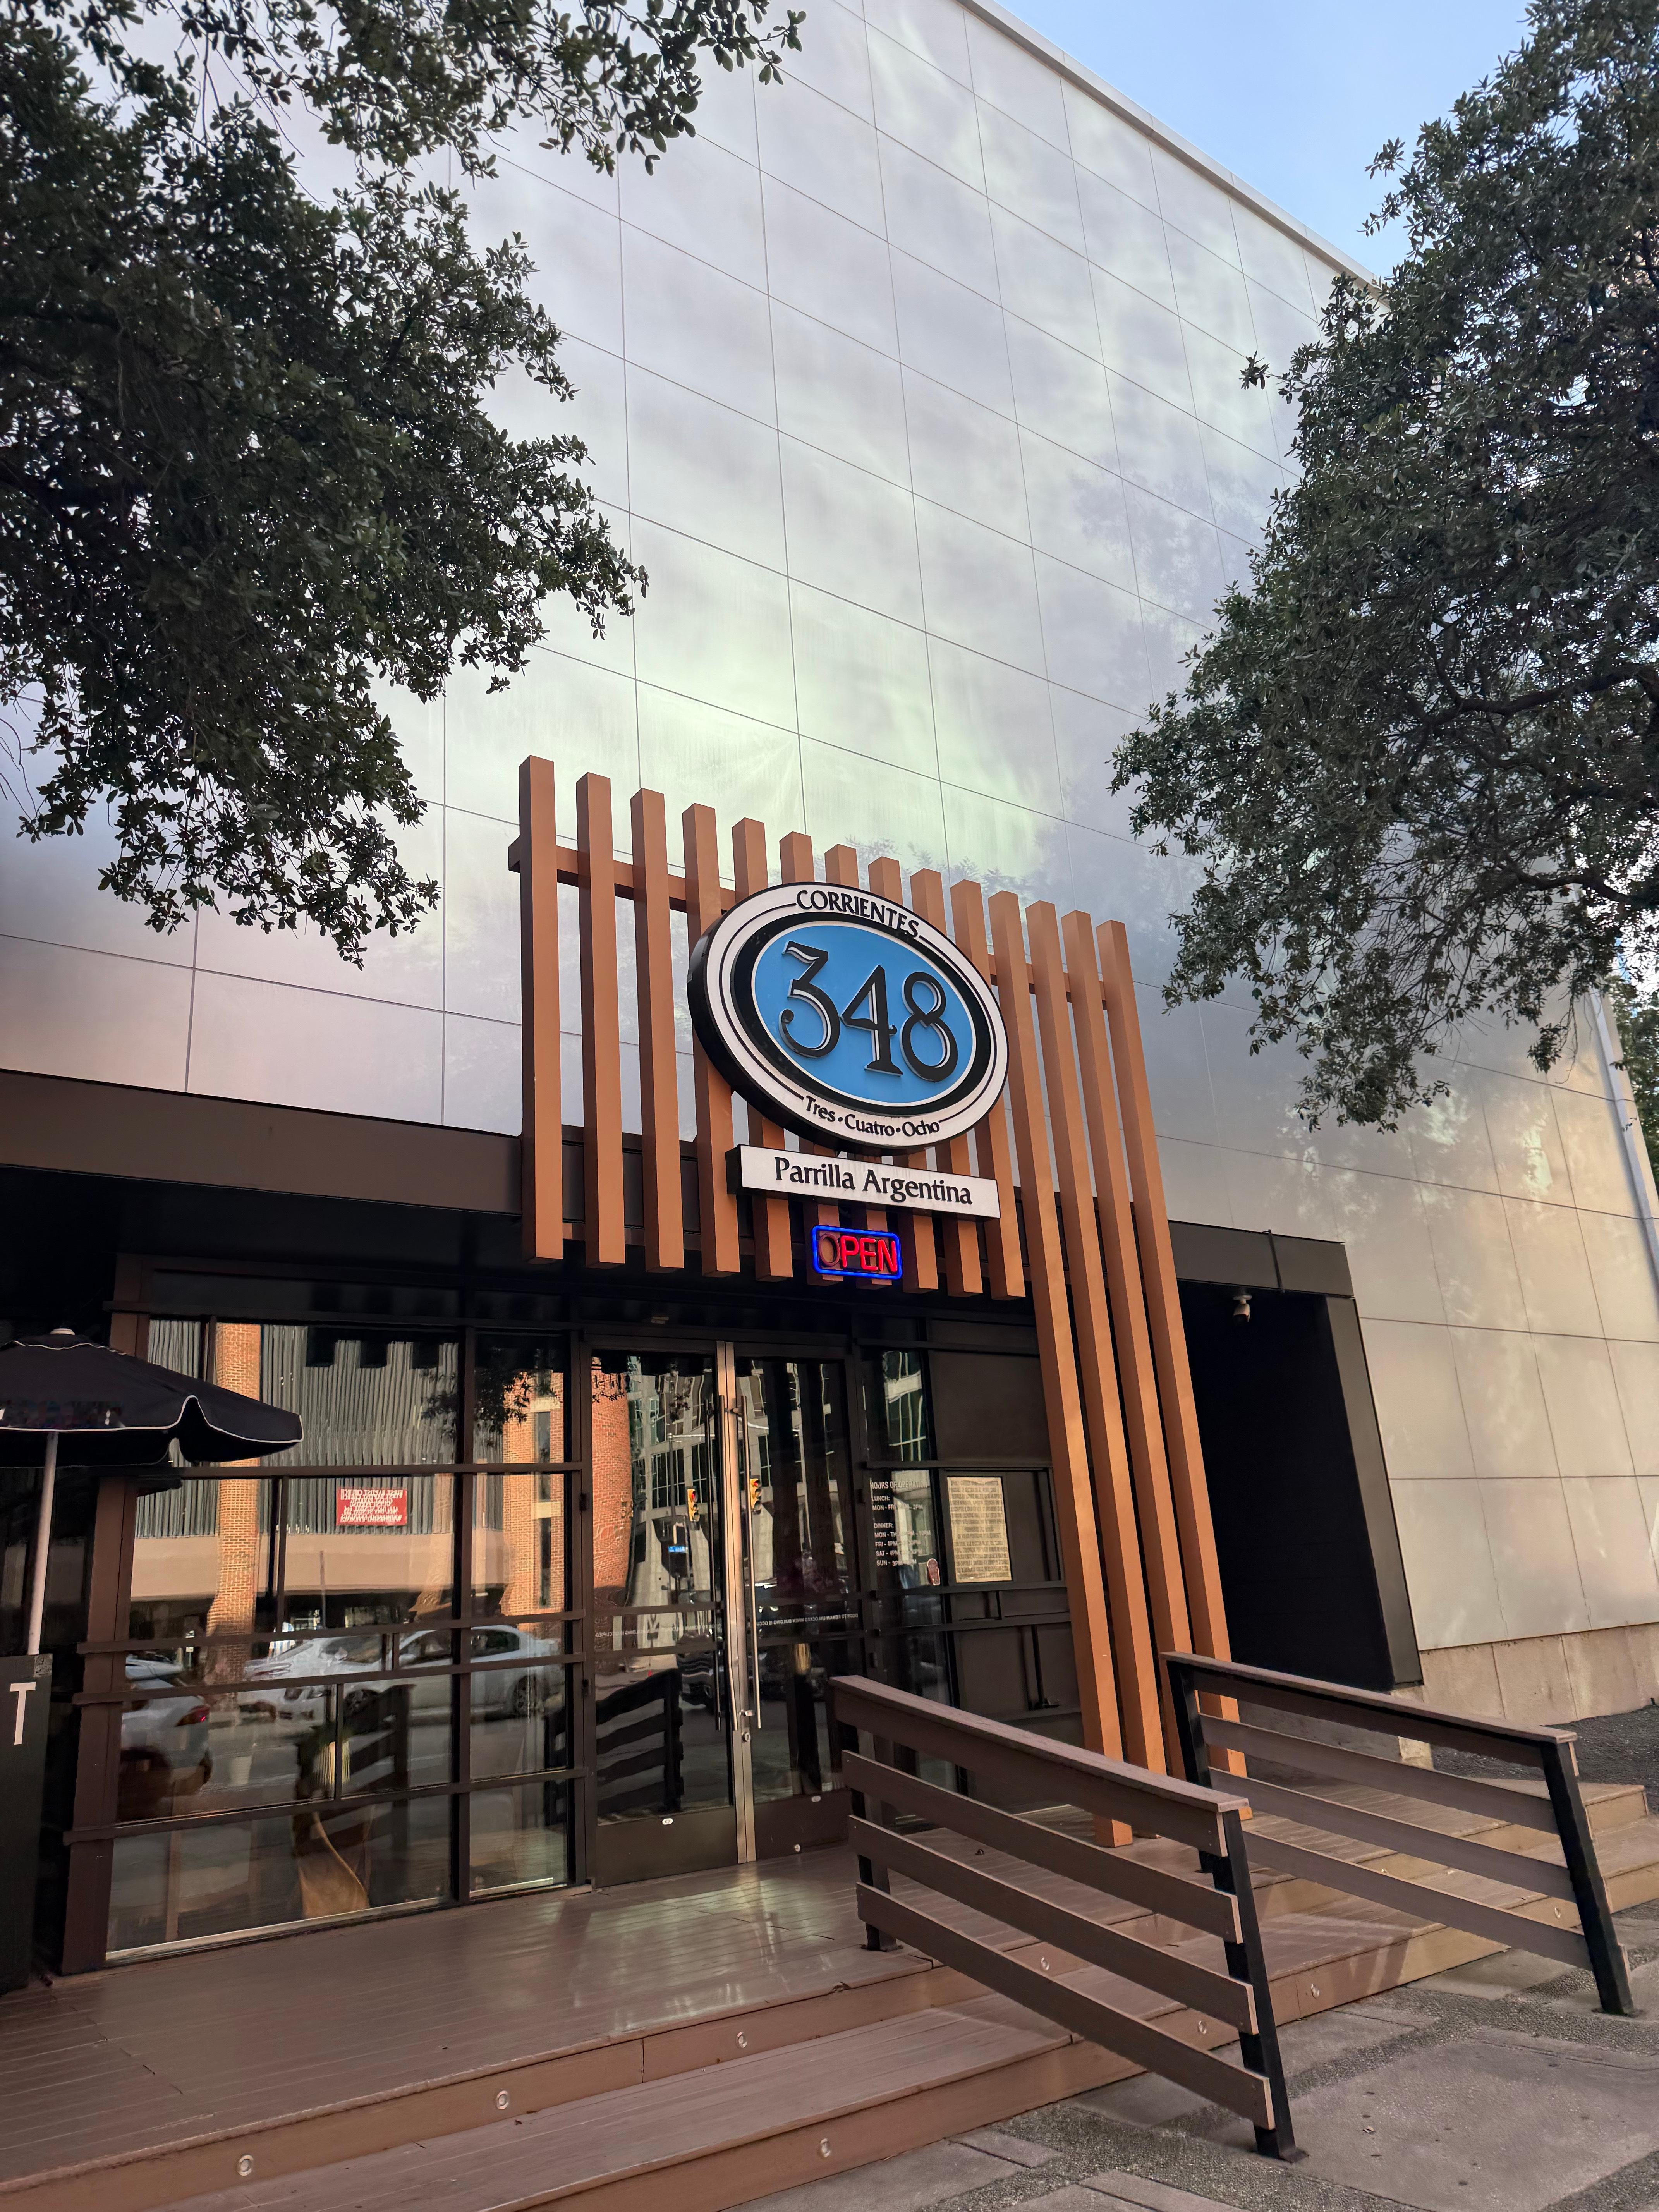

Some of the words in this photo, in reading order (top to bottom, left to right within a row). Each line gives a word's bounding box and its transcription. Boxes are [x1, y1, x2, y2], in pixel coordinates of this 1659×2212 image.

[796, 890, 919, 939] CORRIENTES
[779, 941, 959, 1082] 348
[805, 1096, 837, 1122] Tres
[845, 1114, 895, 1137] Cuatro
[902, 1120, 940, 1136] Ocho
[774, 1157, 855, 1190] Parrilla
[863, 1173, 972, 1204] Argentina
[817, 1232, 898, 1273] OPEN
